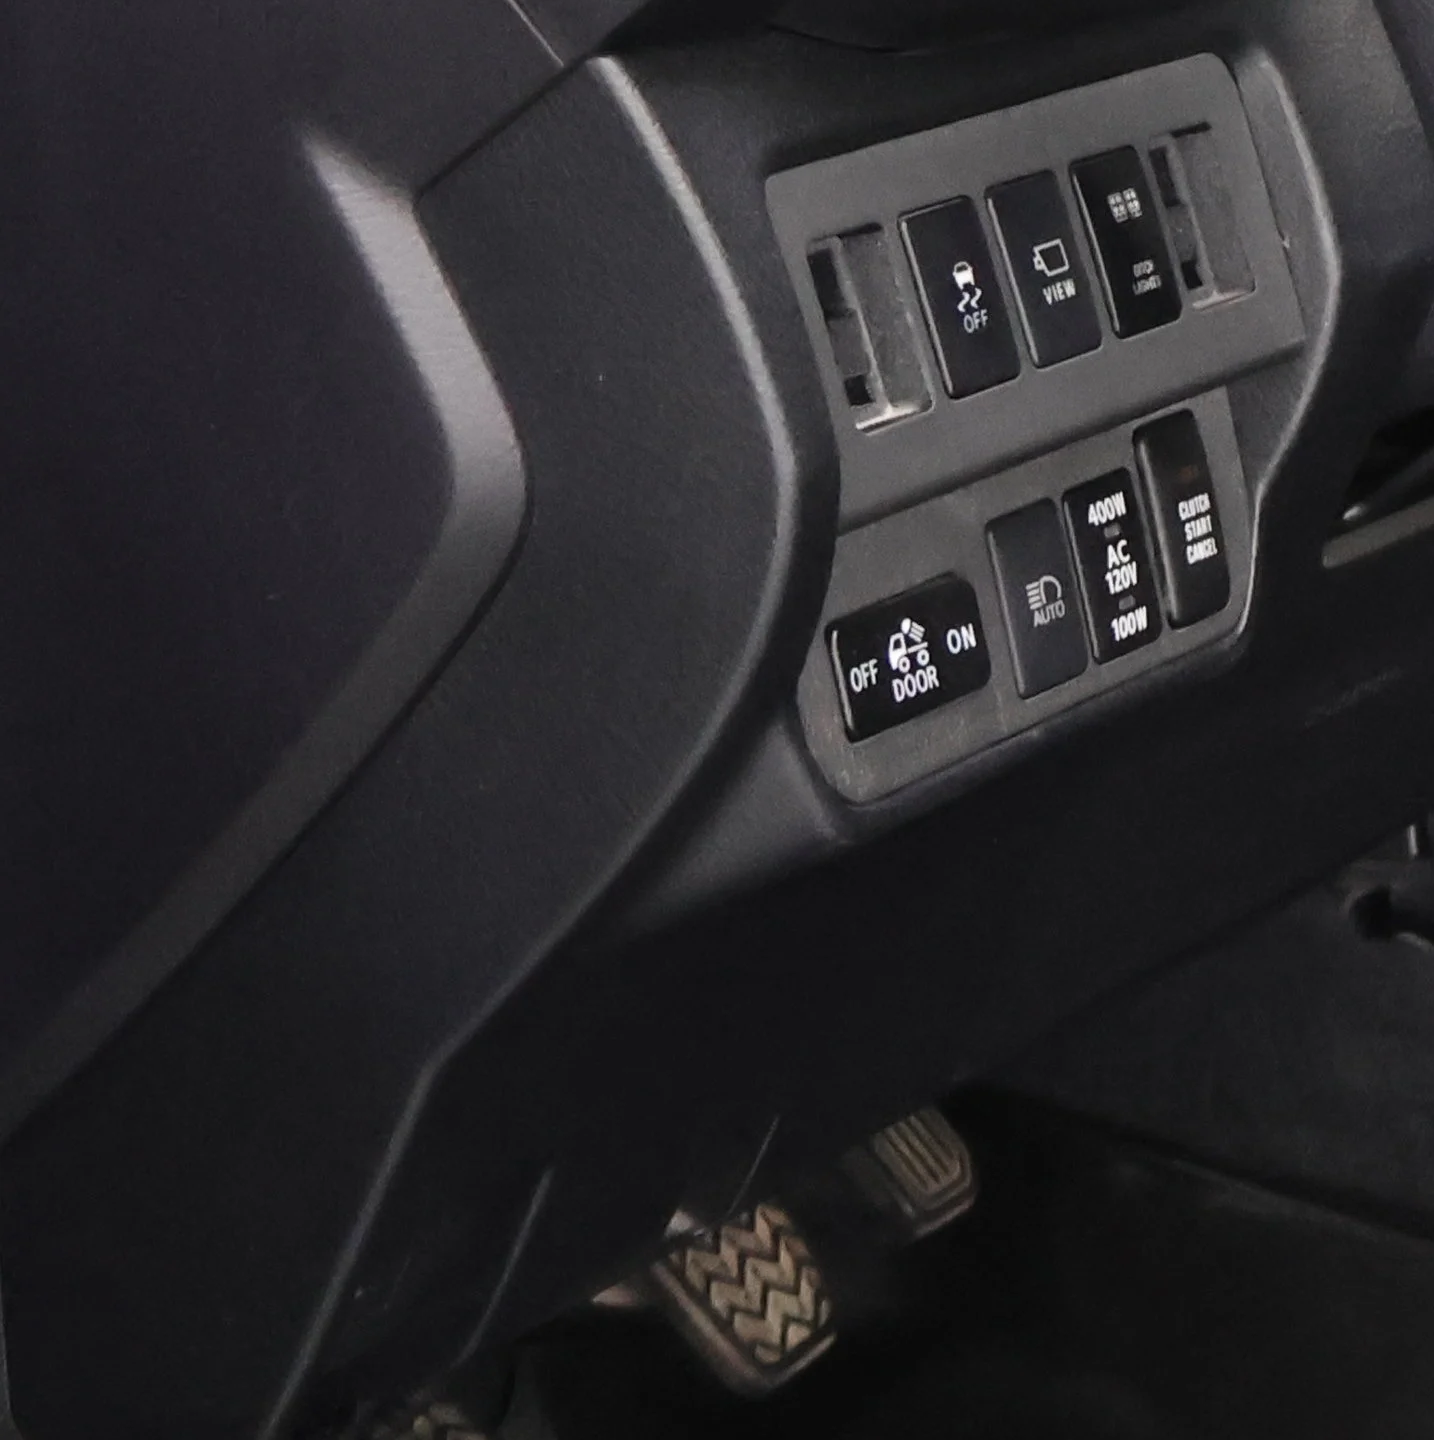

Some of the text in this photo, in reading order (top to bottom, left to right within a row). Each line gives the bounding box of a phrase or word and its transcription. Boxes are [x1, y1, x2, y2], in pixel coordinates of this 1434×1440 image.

[1043, 278, 1076, 305] VIEW
[964, 309, 988, 333] OFF
[1088, 491, 1127, 526] 400W
[1178, 492, 1211, 521] CLUTCH
[1184, 515, 1212, 541] START
[1107, 539, 1131, 569] AC
[1186, 537, 1218, 564] CANCEL
[1105, 561, 1137, 595] 120V
[1033, 599, 1065, 627] AUTO
[1111, 606, 1148, 642] 100W
[946, 623, 976, 654] ON
[850, 659, 878, 692] OFF
[892, 665, 940, 702] DOOR
